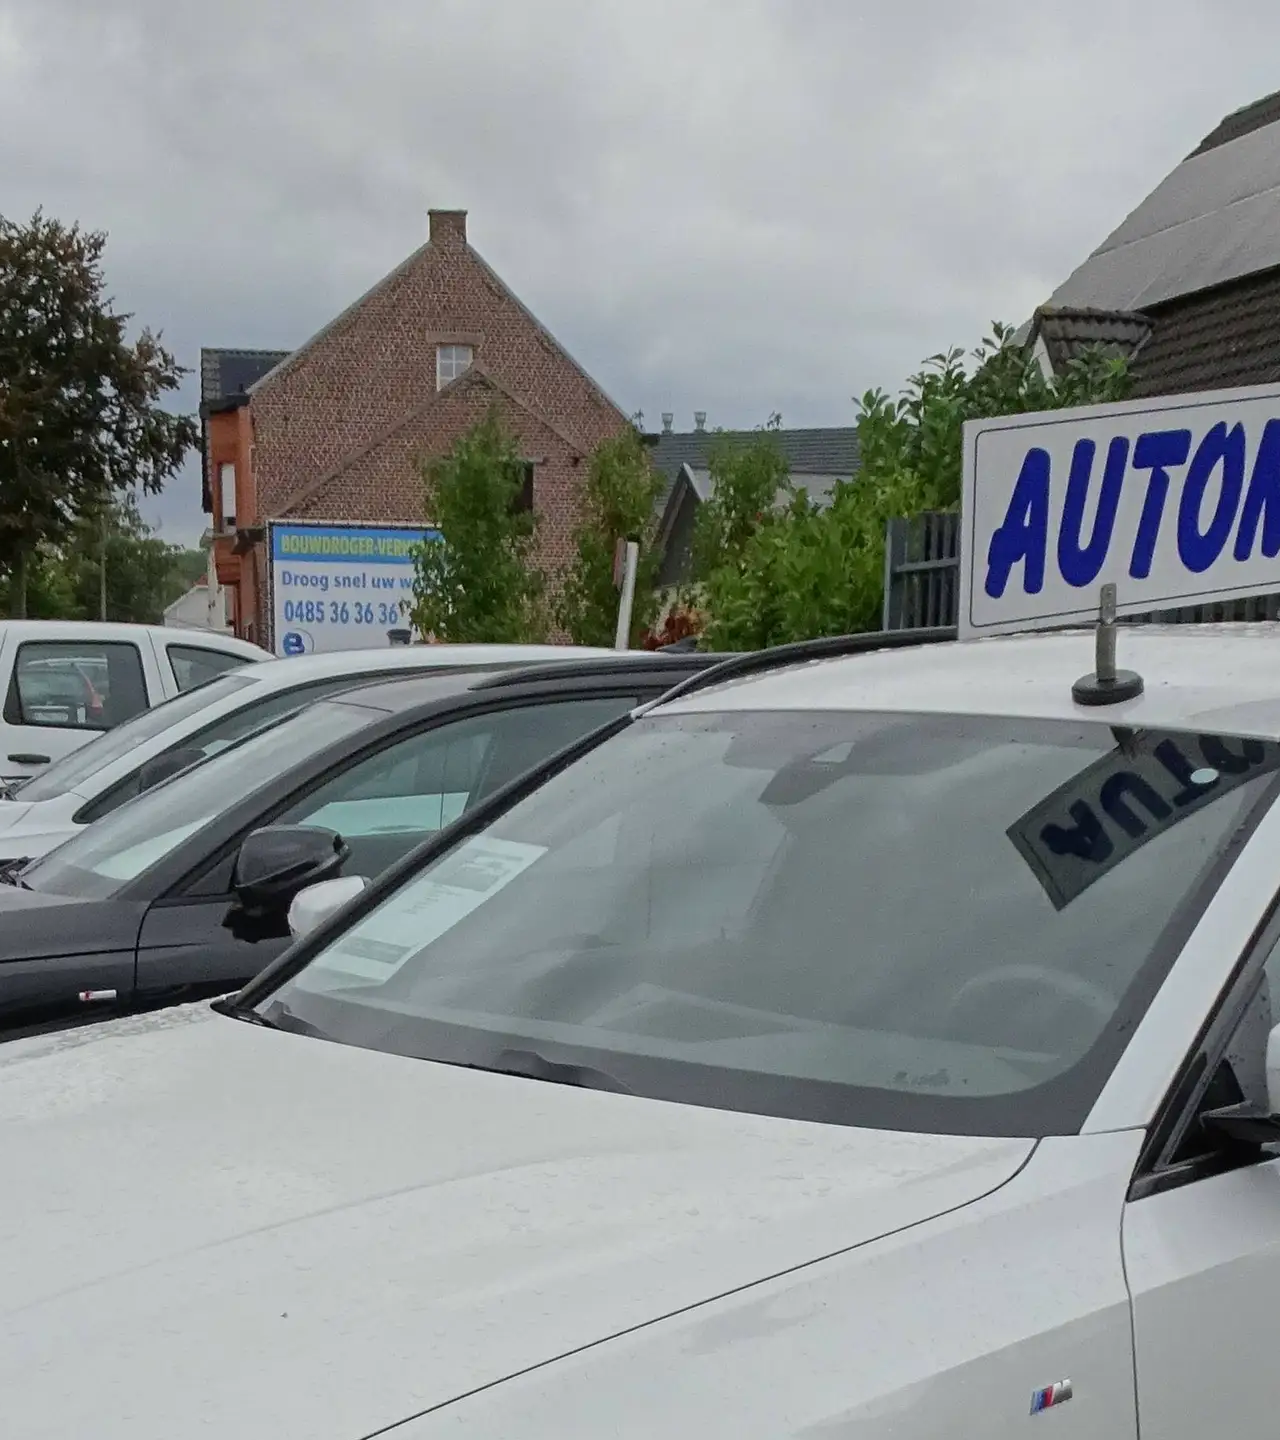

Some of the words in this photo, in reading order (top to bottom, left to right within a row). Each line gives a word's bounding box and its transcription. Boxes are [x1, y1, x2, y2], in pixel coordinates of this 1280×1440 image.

[282, 570, 329, 592] Droog
[334, 573, 366, 589] snel
[371, 577, 395, 589] uw
[284, 600, 325, 623] 0485
[330, 601, 349, 624] 36
[354, 602, 374, 624] 36
[378, 602, 398, 625] 36
